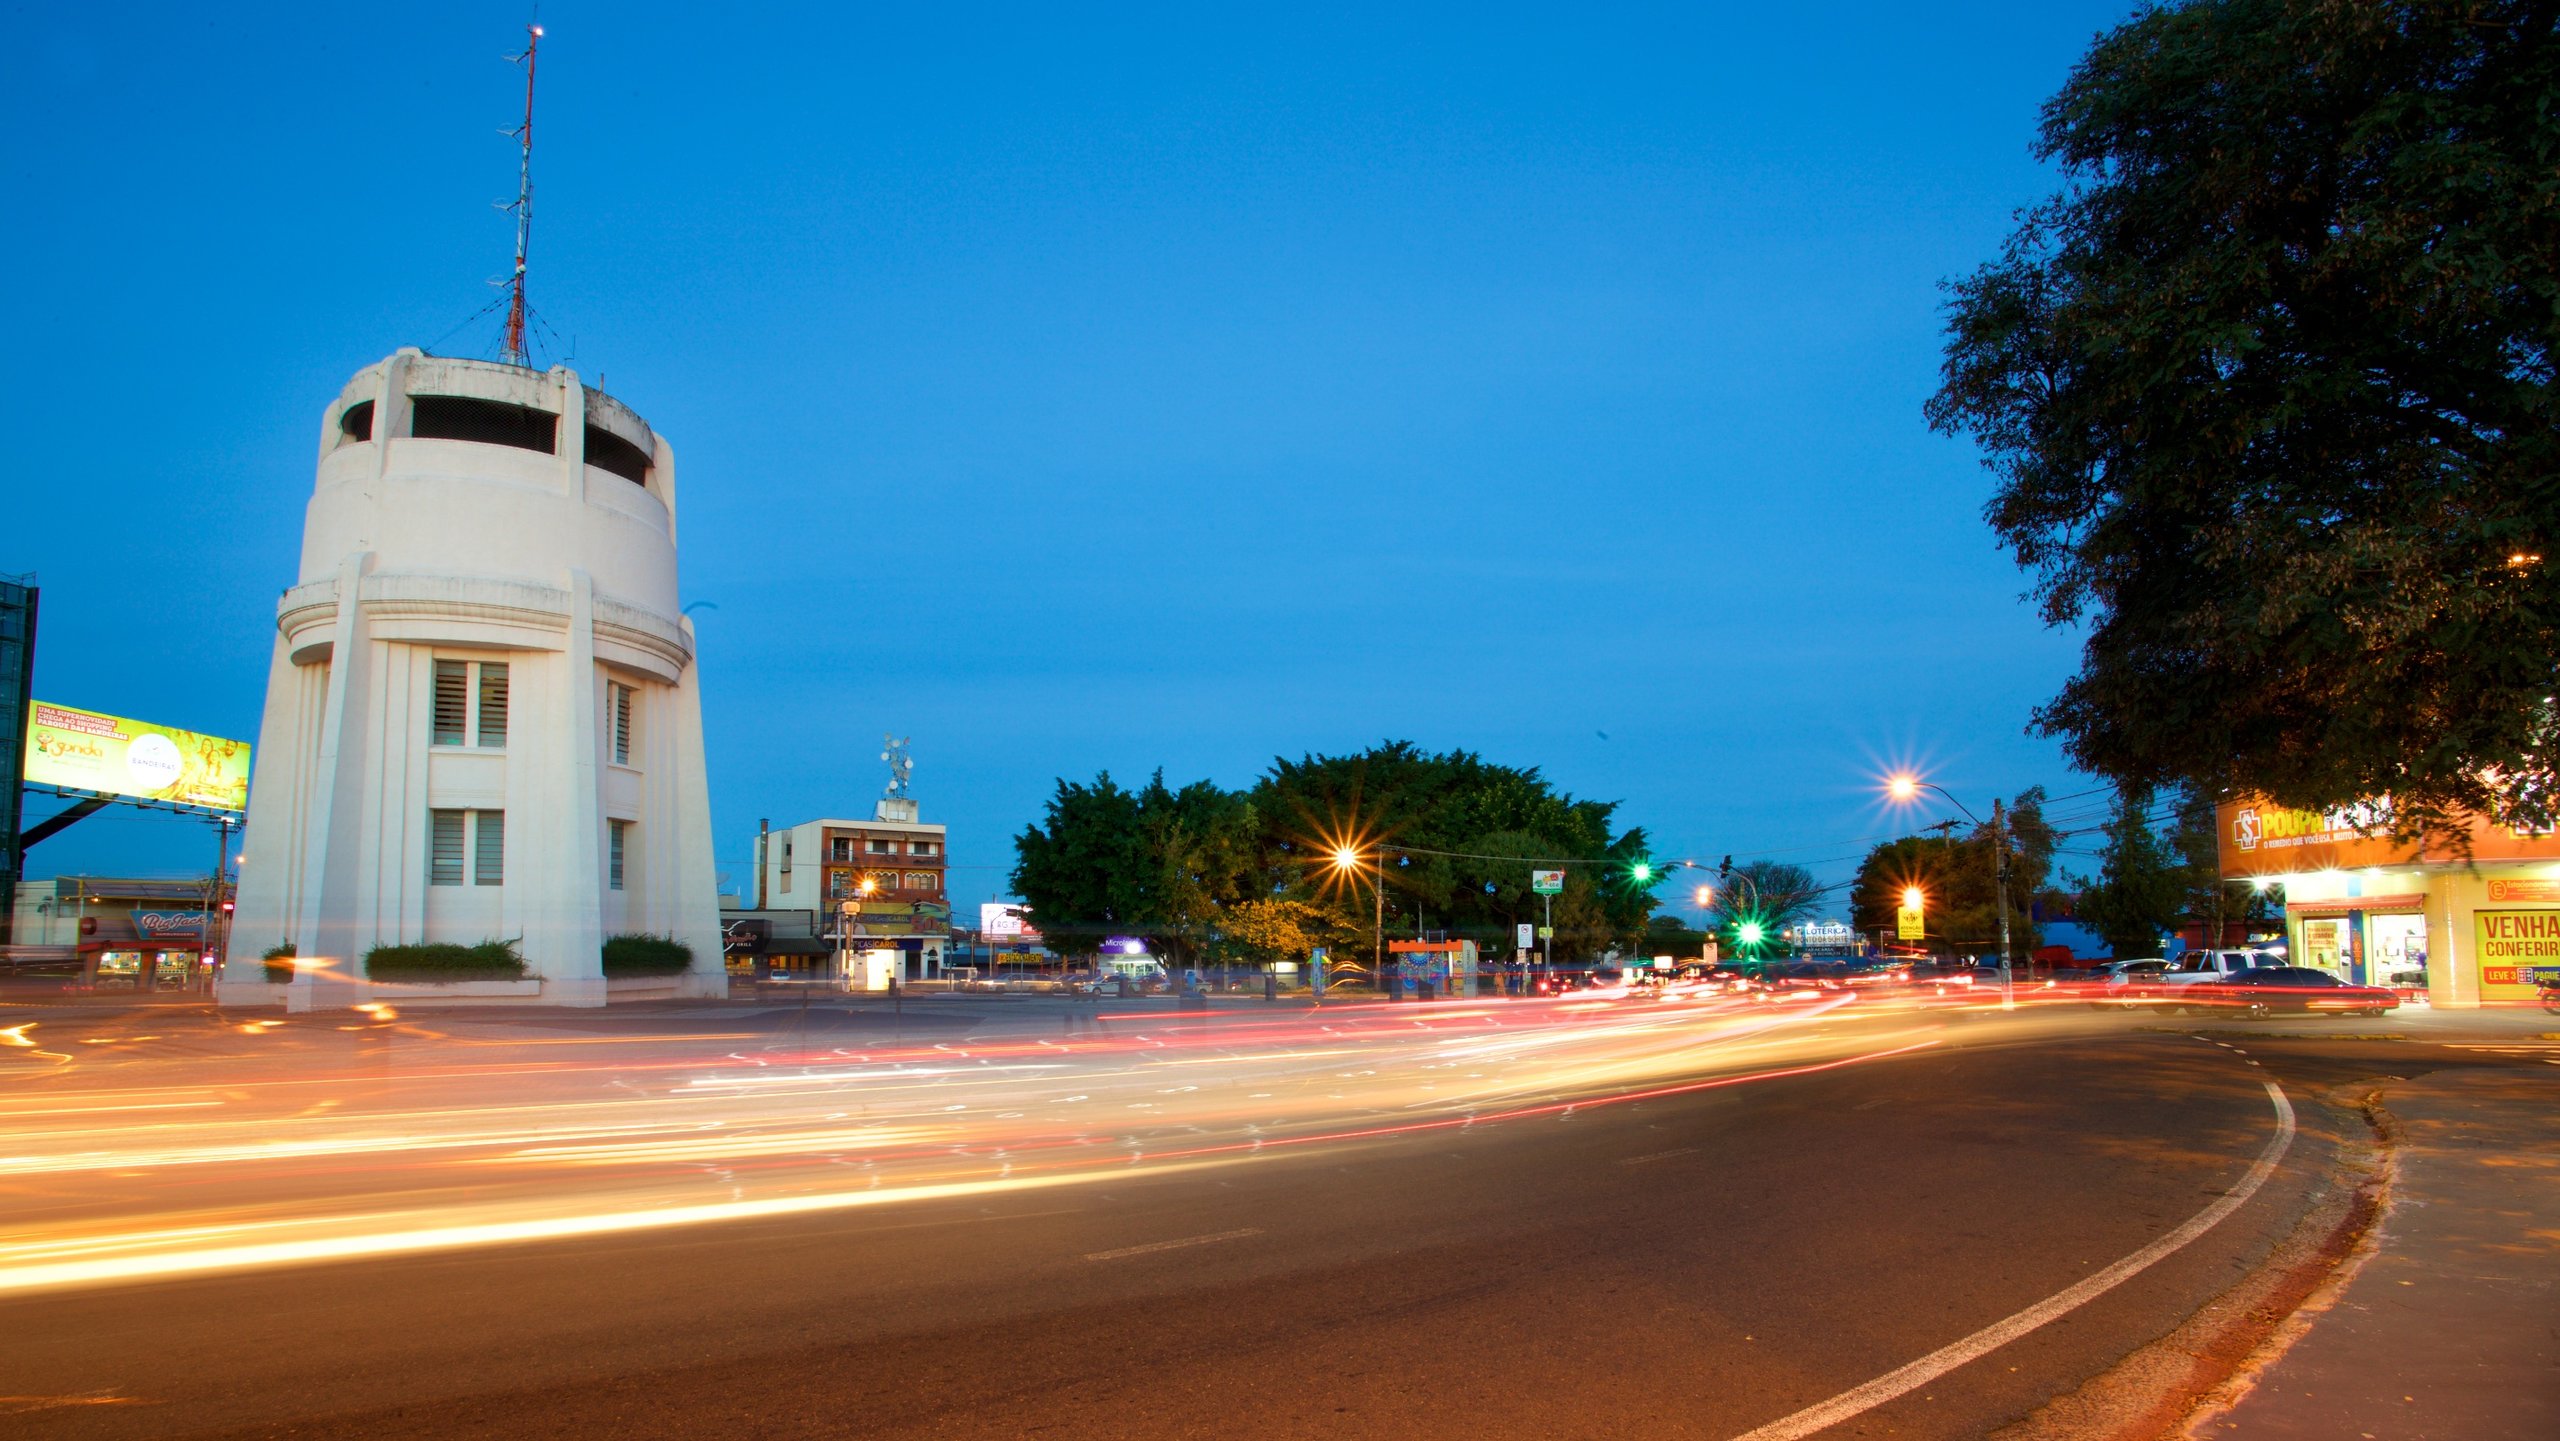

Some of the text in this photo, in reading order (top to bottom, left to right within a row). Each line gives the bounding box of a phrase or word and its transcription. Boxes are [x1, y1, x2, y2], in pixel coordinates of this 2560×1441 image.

[38, 706, 56, 716] UMA
[37, 712, 64, 723] CHEGA
[76, 720, 113, 733] SHOPPING
[37, 718, 129, 740] PARQUE DAS BANDEIRAS
[2483, 915, 2560, 939] VENHA
[874, 940, 900, 949] CAROL
[2485, 941, 2560, 957] CONFERIR
[2489, 970, 2509, 981] LEVE
[2510, 970, 2517, 981] 3
